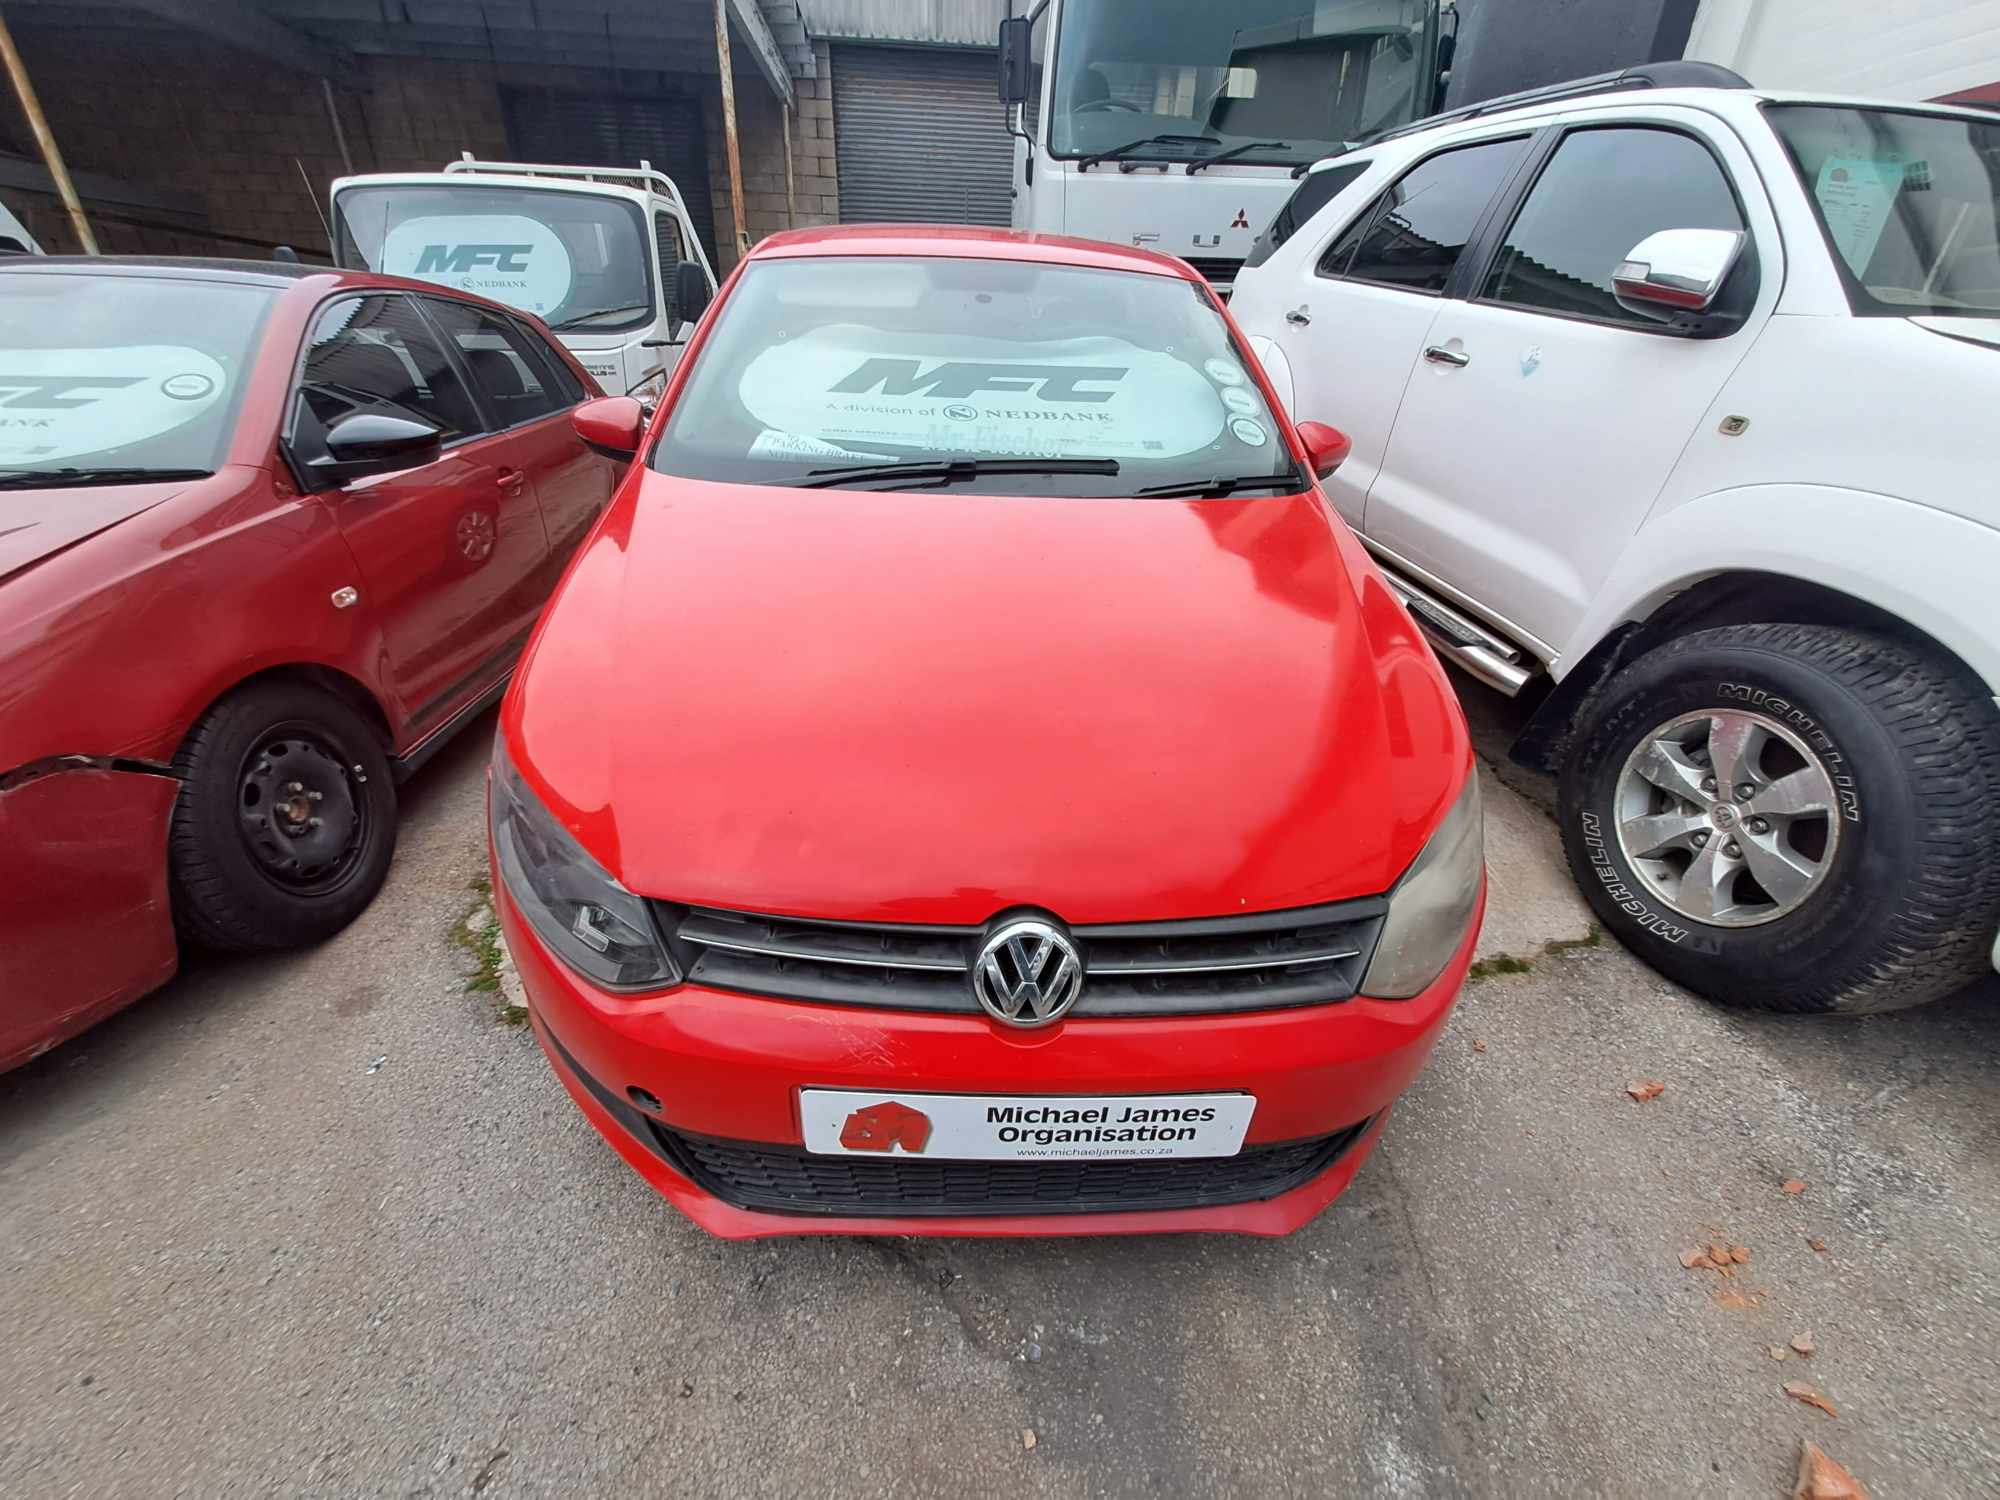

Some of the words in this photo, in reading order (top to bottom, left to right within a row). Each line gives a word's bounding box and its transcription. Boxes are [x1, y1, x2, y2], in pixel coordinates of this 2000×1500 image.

[414, 244, 534, 274] MFC
[475, 279, 527, 288] NEDBANK
[826, 357, 1130, 403] MFC
[843, 403, 913, 416] division
[918, 407, 935, 417] of
[985, 408, 1114, 423] NEDBANK
[1716, 682, 1860, 823] MICHELIN
[1582, 812, 1689, 944] MICHELIN
[986, 1106, 1109, 1124] Michael
[1116, 1106, 1216, 1123] James
[998, 1125, 1196, 1145] Organisation
[1016, 1147, 1173, 1157] www.michaeljames.co.za
